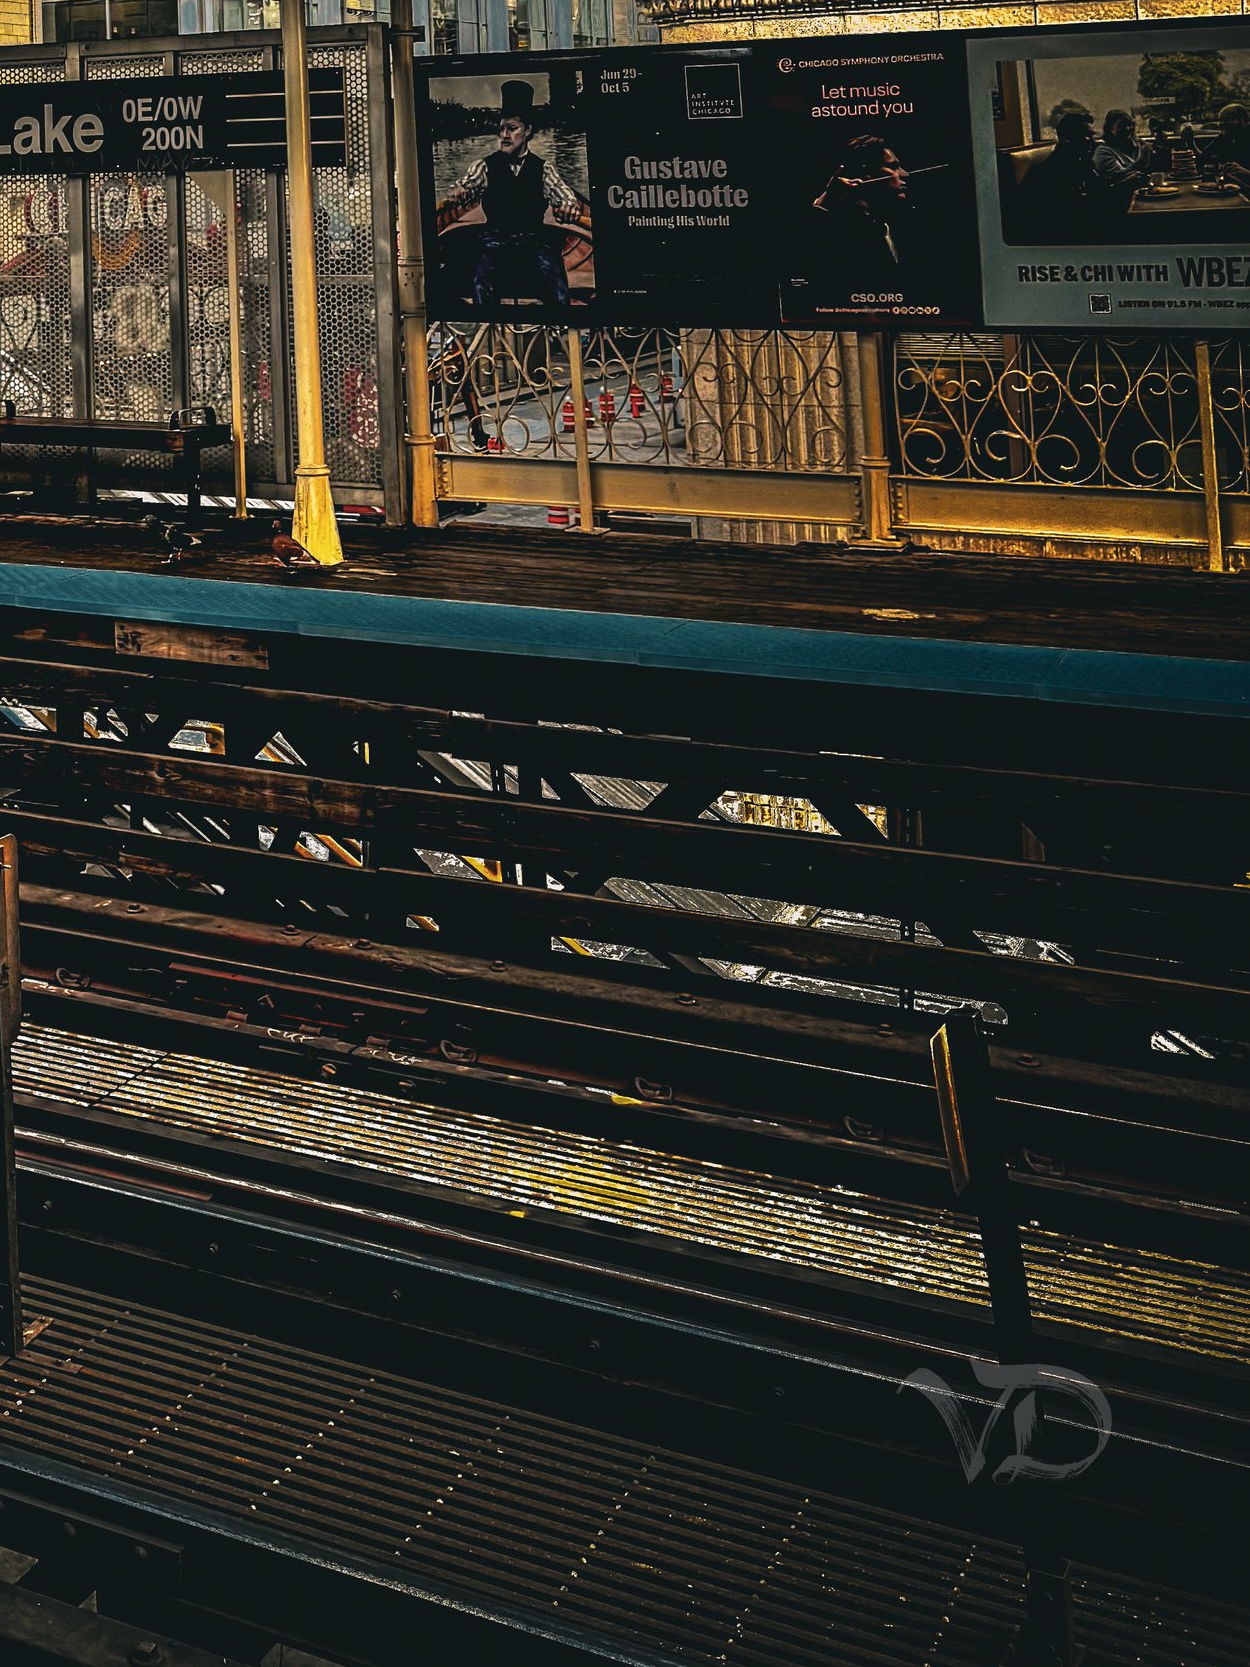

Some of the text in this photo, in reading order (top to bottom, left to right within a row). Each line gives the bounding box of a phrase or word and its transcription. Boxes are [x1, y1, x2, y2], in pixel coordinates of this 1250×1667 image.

[798, 52, 945, 69] CHICAGO SYMPHONY ORCHESTRA
[600, 69, 621, 80] Jun
[601, 82, 630, 94] Oct 5
[821, 82, 900, 99] Let music
[121, 95, 204, 124] 0E/0W
[692, 107, 732, 116] CHICAGO
[811, 100, 914, 118] astound you
[142, 124, 204, 152] 200N
[623, 155, 728, 180] Gustave
[607, 184, 750, 209] Caillebotte
[628, 215, 731, 229] Painting His World
[1017, 265, 1061, 283] RISE
[1063, 265, 1080, 283] &
[1080, 264, 1114, 282] CHI
[1116, 264, 1169, 282] WITH
[850, 293, 904, 304] CSO.ORG
[1118, 300, 1151, 309] LISTEN
[1151, 300, 1166, 308] ON
[1167, 299, 1187, 308] 91.5
[1187, 300, 1202, 308] FM
[1207, 299, 1235, 308] WBEZ
